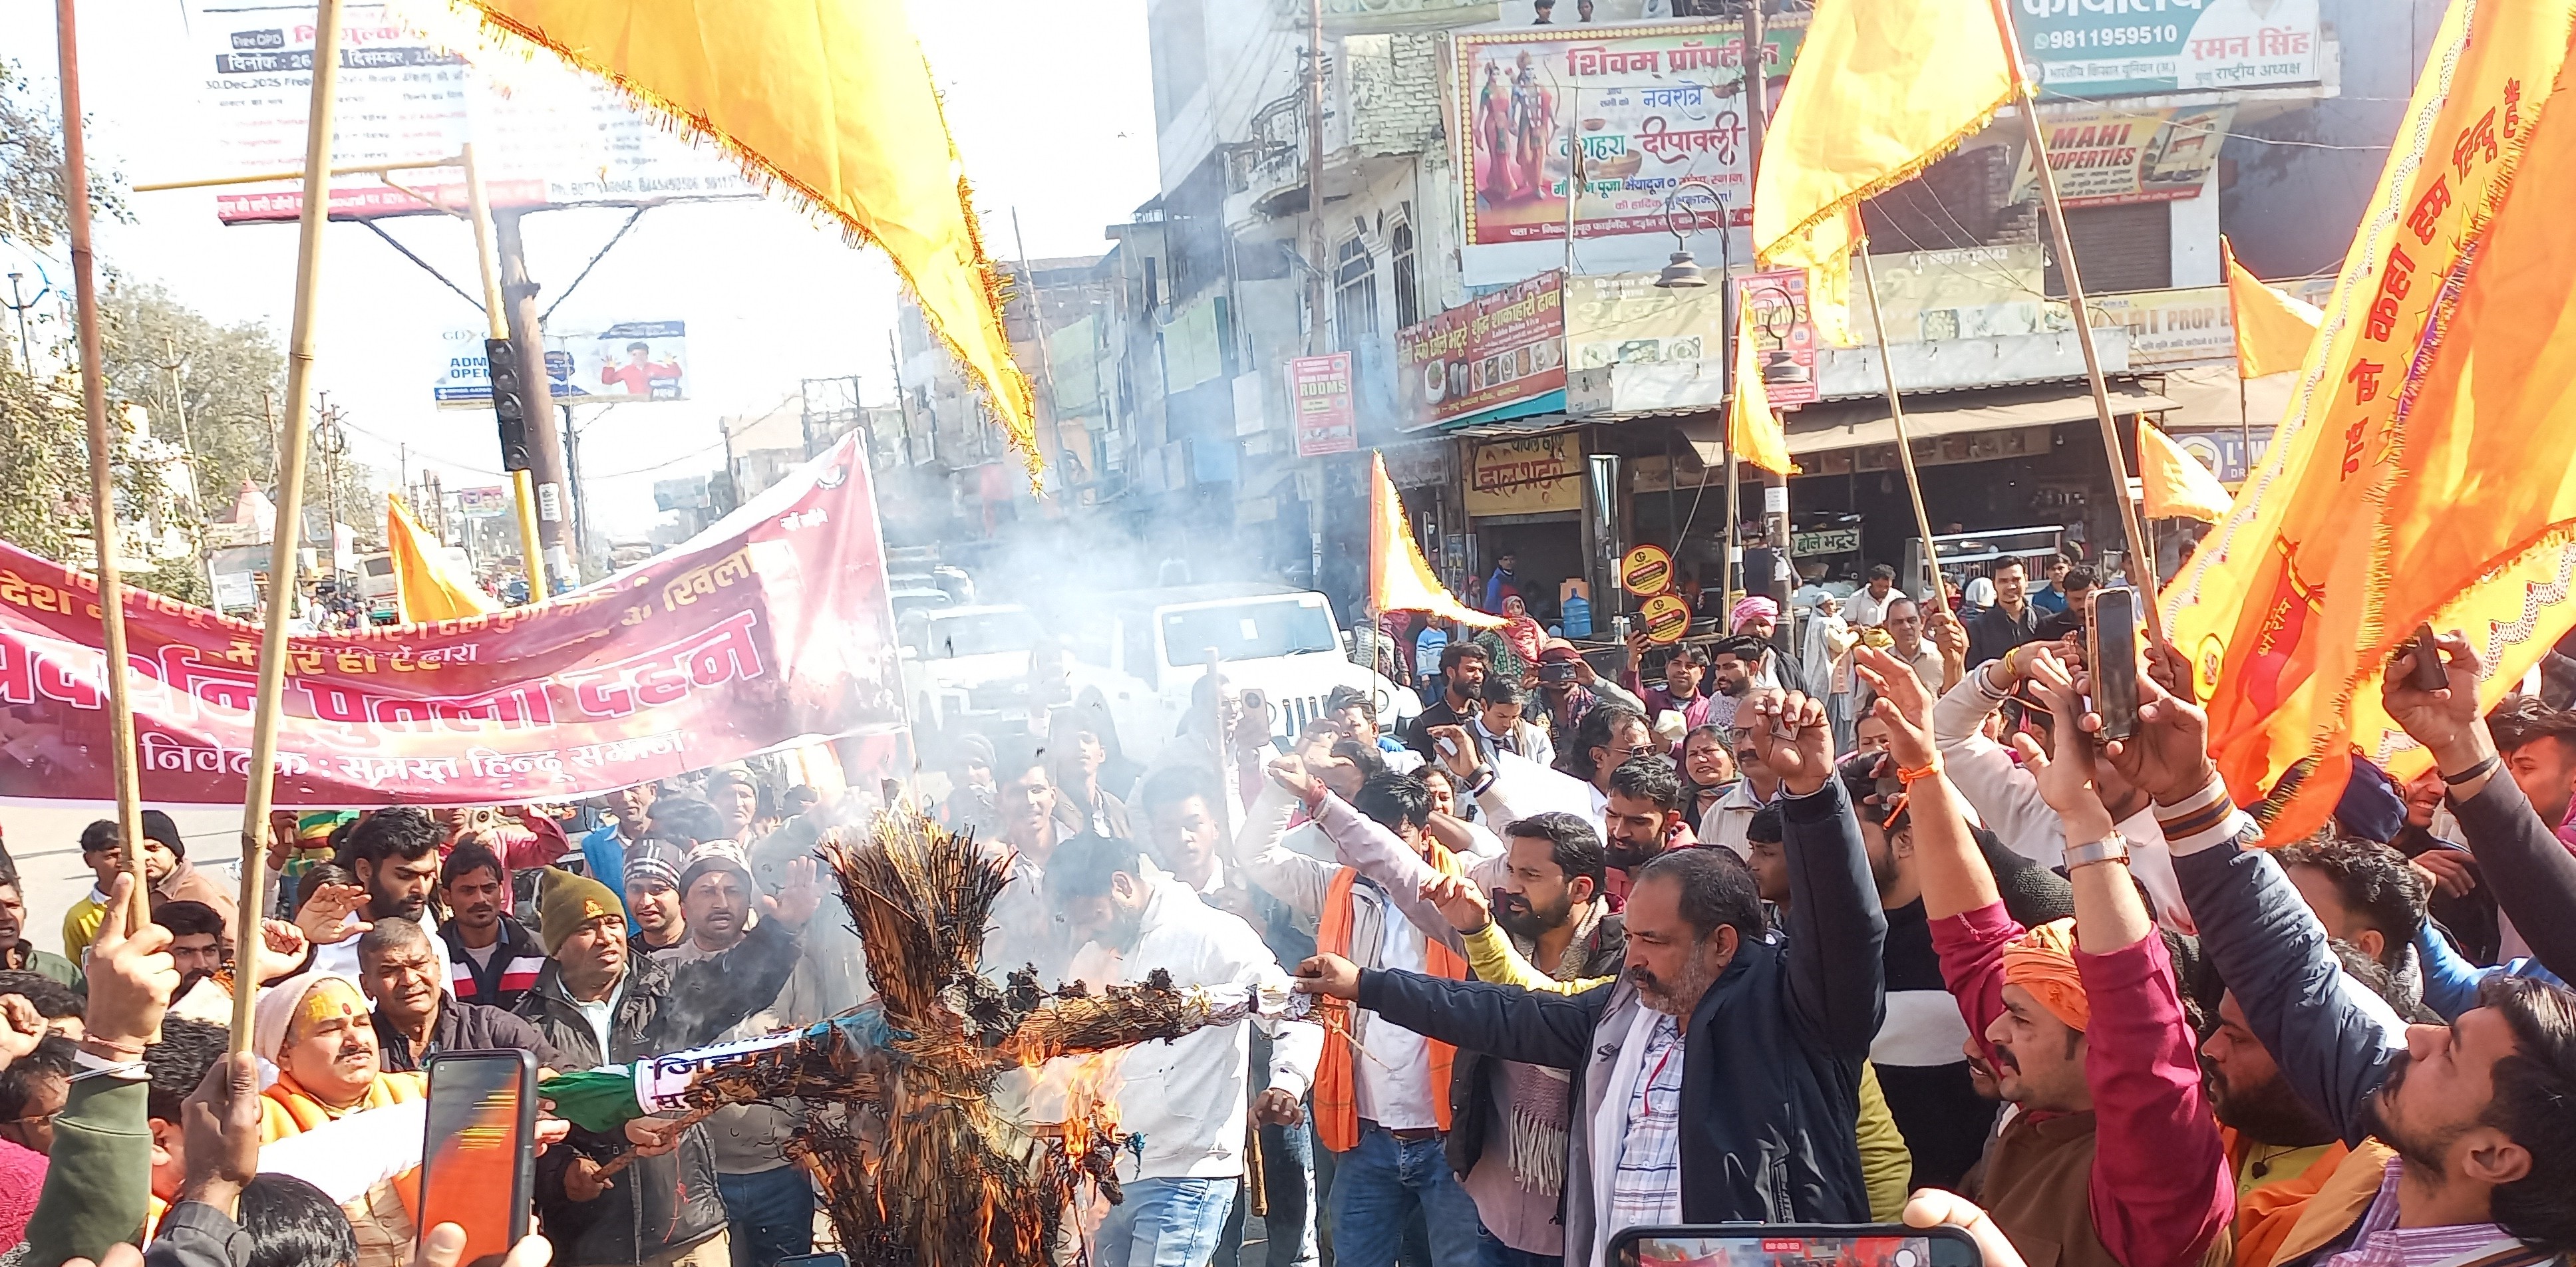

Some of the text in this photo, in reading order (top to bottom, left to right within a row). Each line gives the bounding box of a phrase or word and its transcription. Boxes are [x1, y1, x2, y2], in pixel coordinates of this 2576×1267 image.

[256, 33, 282, 45] OPD
[2050, 24, 2178, 49] 9811959510
[2190, 26, 2311, 61] रमन सिंह
[290, 54, 312, 69] 26
[2260, 63, 2301, 76] अध्यक्ष
[1633, 110, 1747, 167] दीपावली
[2049, 123, 2133, 150] MAHI
[2027, 147, 2137, 173] OPERTIES
[2406, 173, 2452, 246] हम
[1491, 291, 1535, 328] शाकाहारी
[2168, 307, 2234, 332] PROPE
[450, 357, 487, 367] ADM
[1299, 380, 1347, 397] ROOMS
[2231, 468, 2247, 478] DR
[558, 609, 765, 718] दहन
